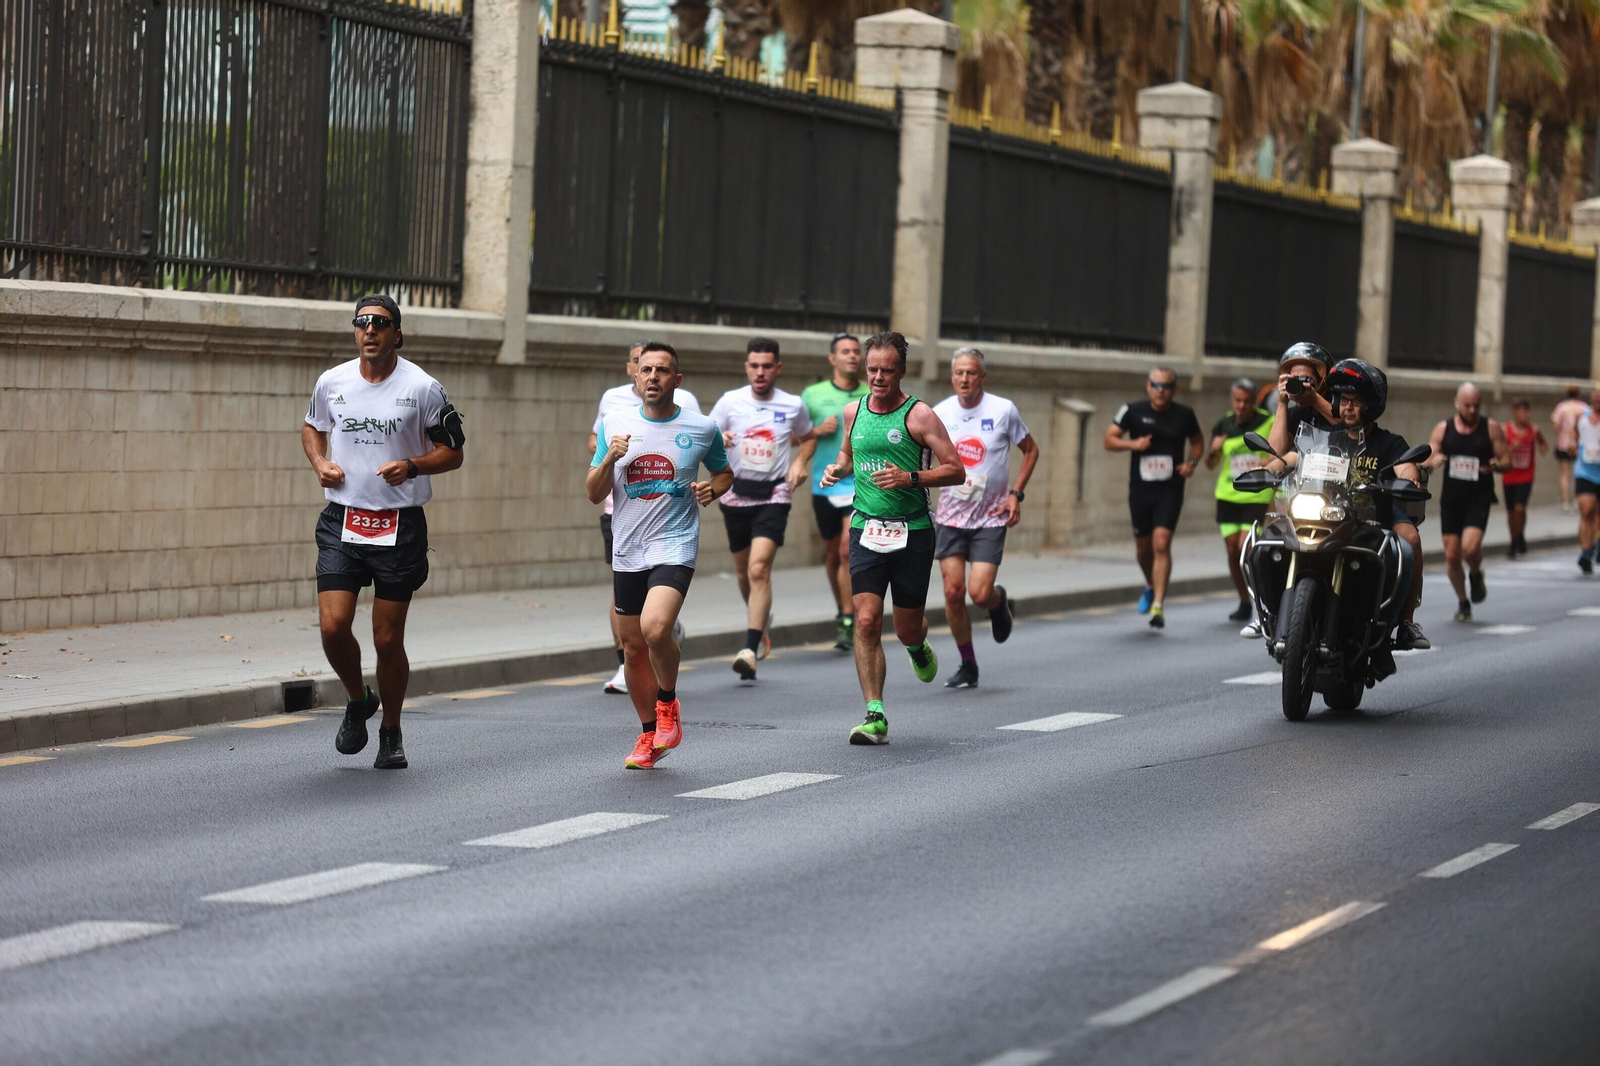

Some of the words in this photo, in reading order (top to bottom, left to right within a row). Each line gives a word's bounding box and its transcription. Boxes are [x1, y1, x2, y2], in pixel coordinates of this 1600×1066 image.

[745, 447, 772, 458] 1359
[634, 459, 652, 467] Café
[351, 515, 391, 533] 2323
[868, 527, 901, 538] 1172
